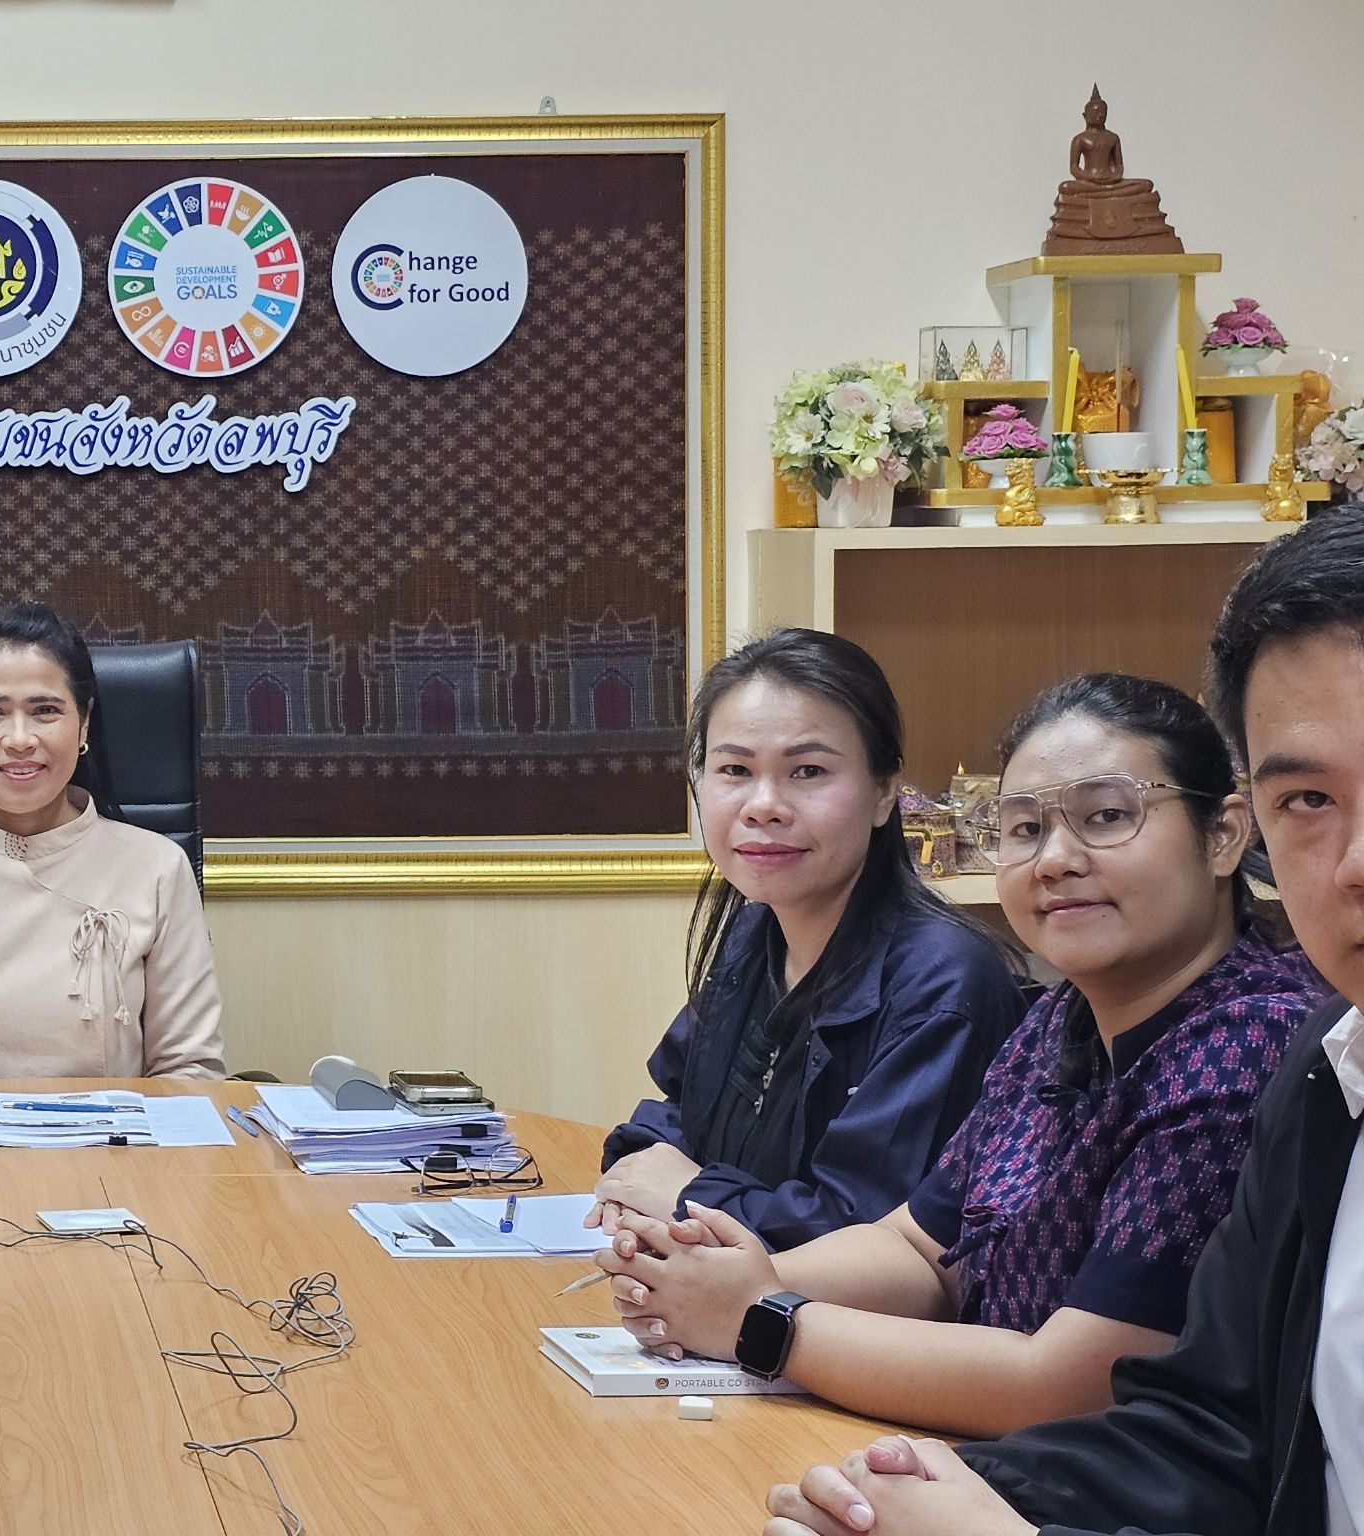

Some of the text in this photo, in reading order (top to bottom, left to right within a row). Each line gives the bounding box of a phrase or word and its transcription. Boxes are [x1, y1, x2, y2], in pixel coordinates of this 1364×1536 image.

[176, 266, 237, 275] SUSTAINABLE
[176, 275, 237, 284] DEVELOPMENT
[177, 284, 238, 300] GOALS
[408, 281, 509, 303] for Good
[675, 1379, 725, 1388] PORTABLE
[728, 1378, 742, 1387] CD
